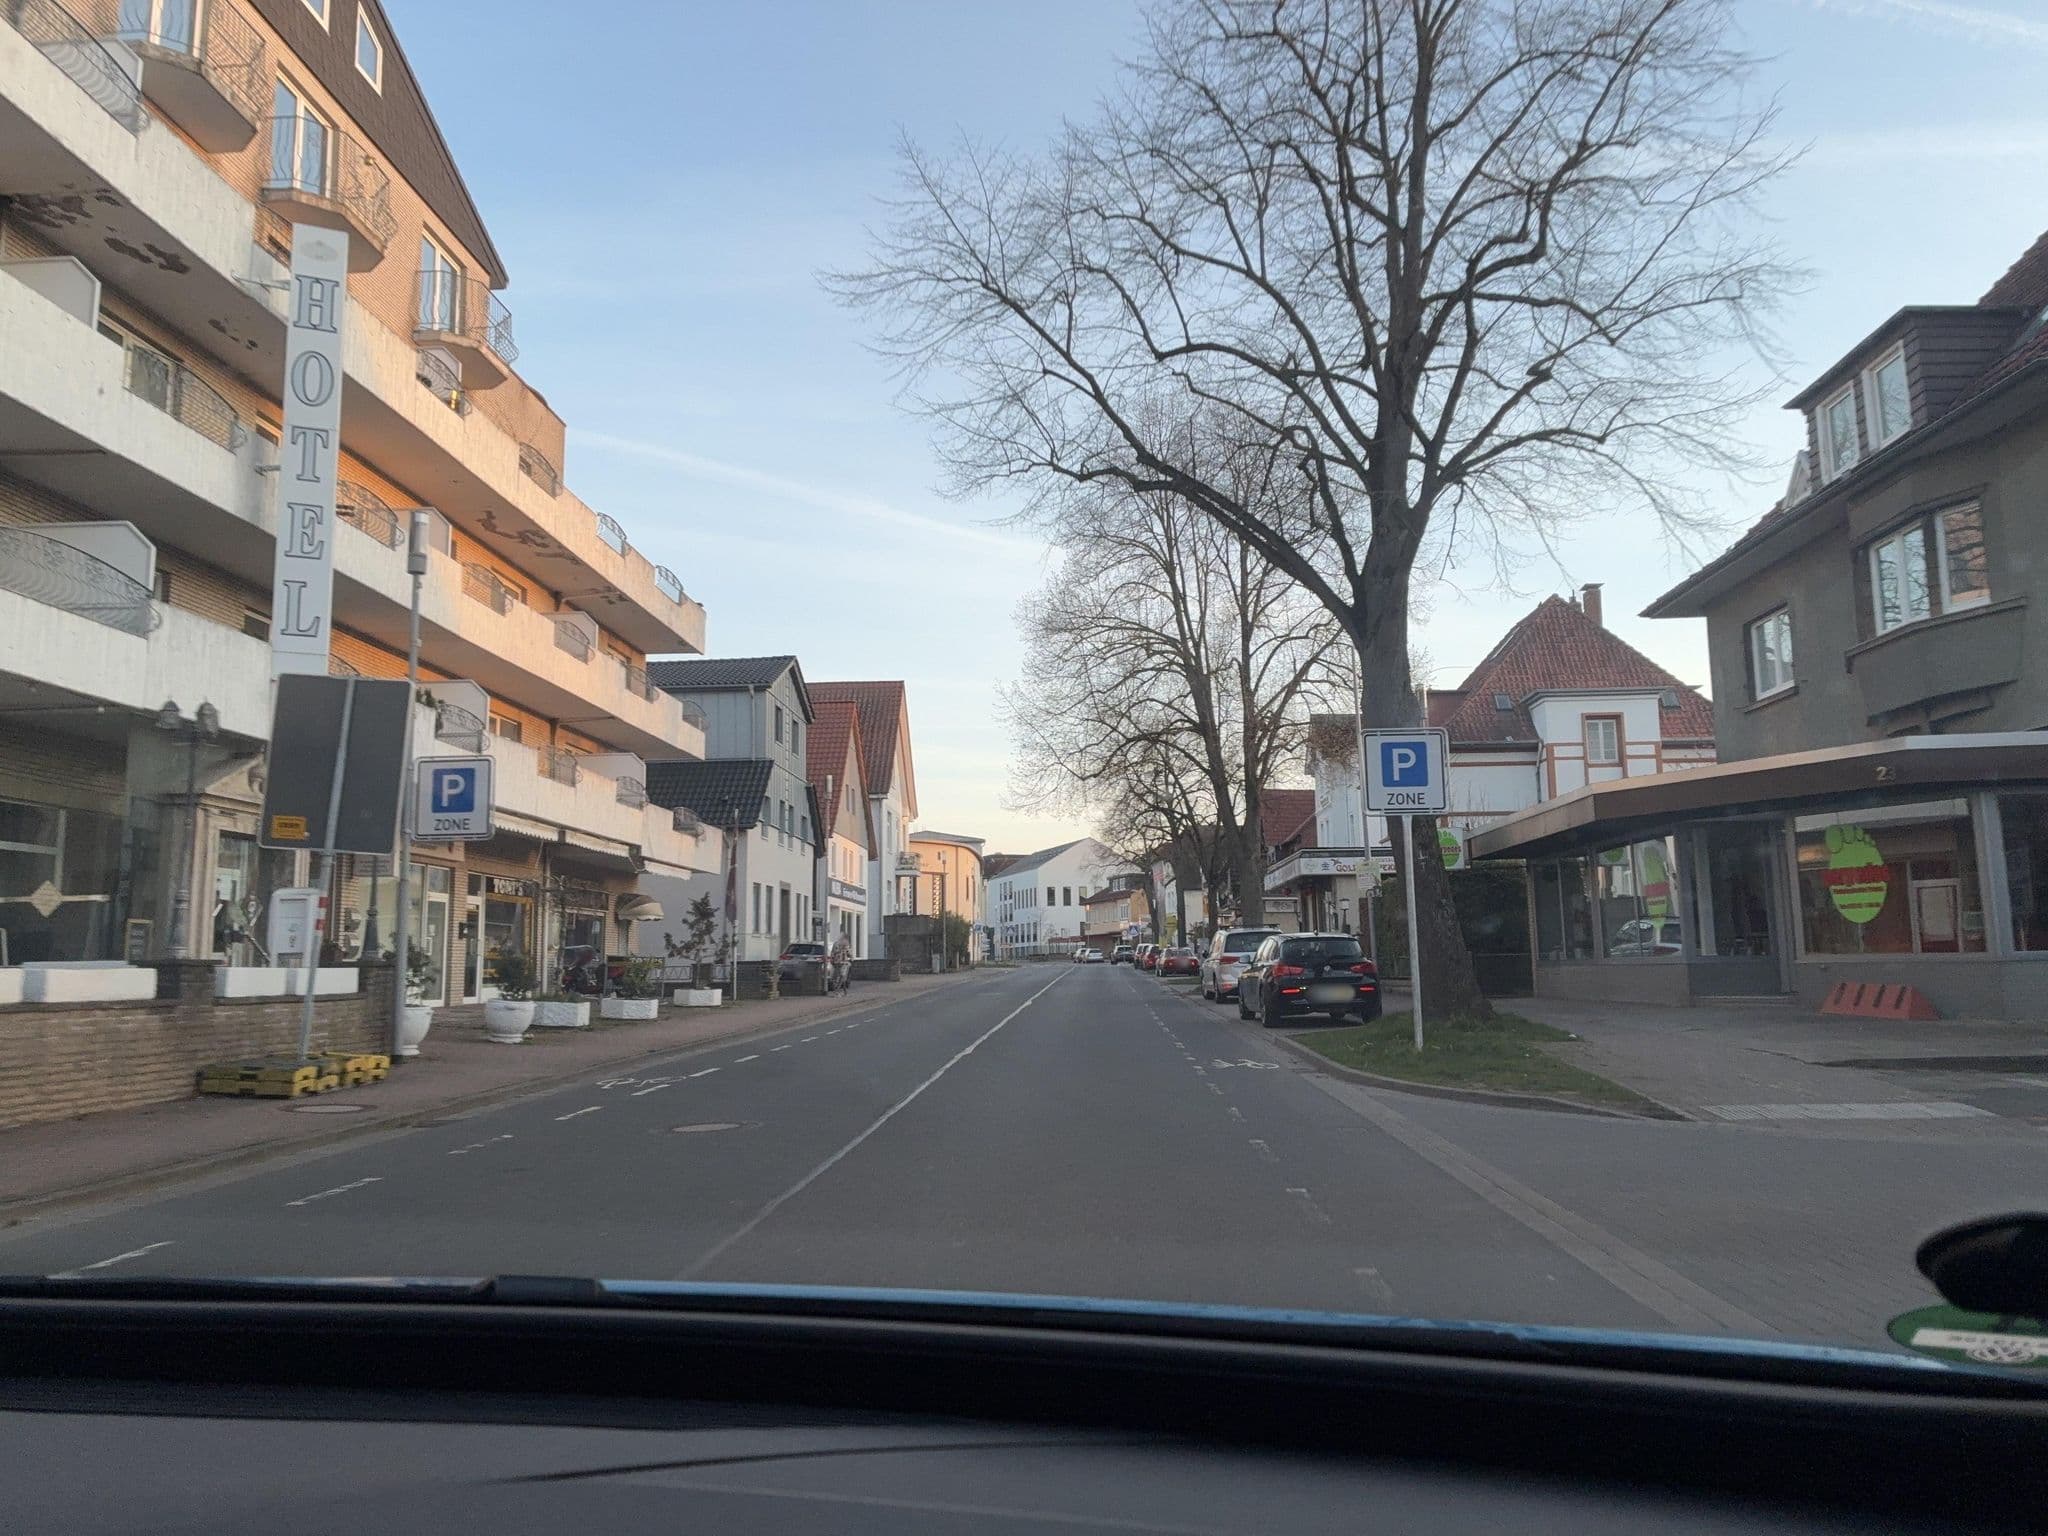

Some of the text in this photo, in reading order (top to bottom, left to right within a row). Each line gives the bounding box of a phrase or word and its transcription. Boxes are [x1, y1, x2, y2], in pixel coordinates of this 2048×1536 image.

[281, 274, 339, 638] HOTEL
[1392, 748, 1417, 782] P
[442, 774, 465, 807] P
[1387, 792, 1426, 805] ZONE
[434, 818, 471, 831] ZONE
